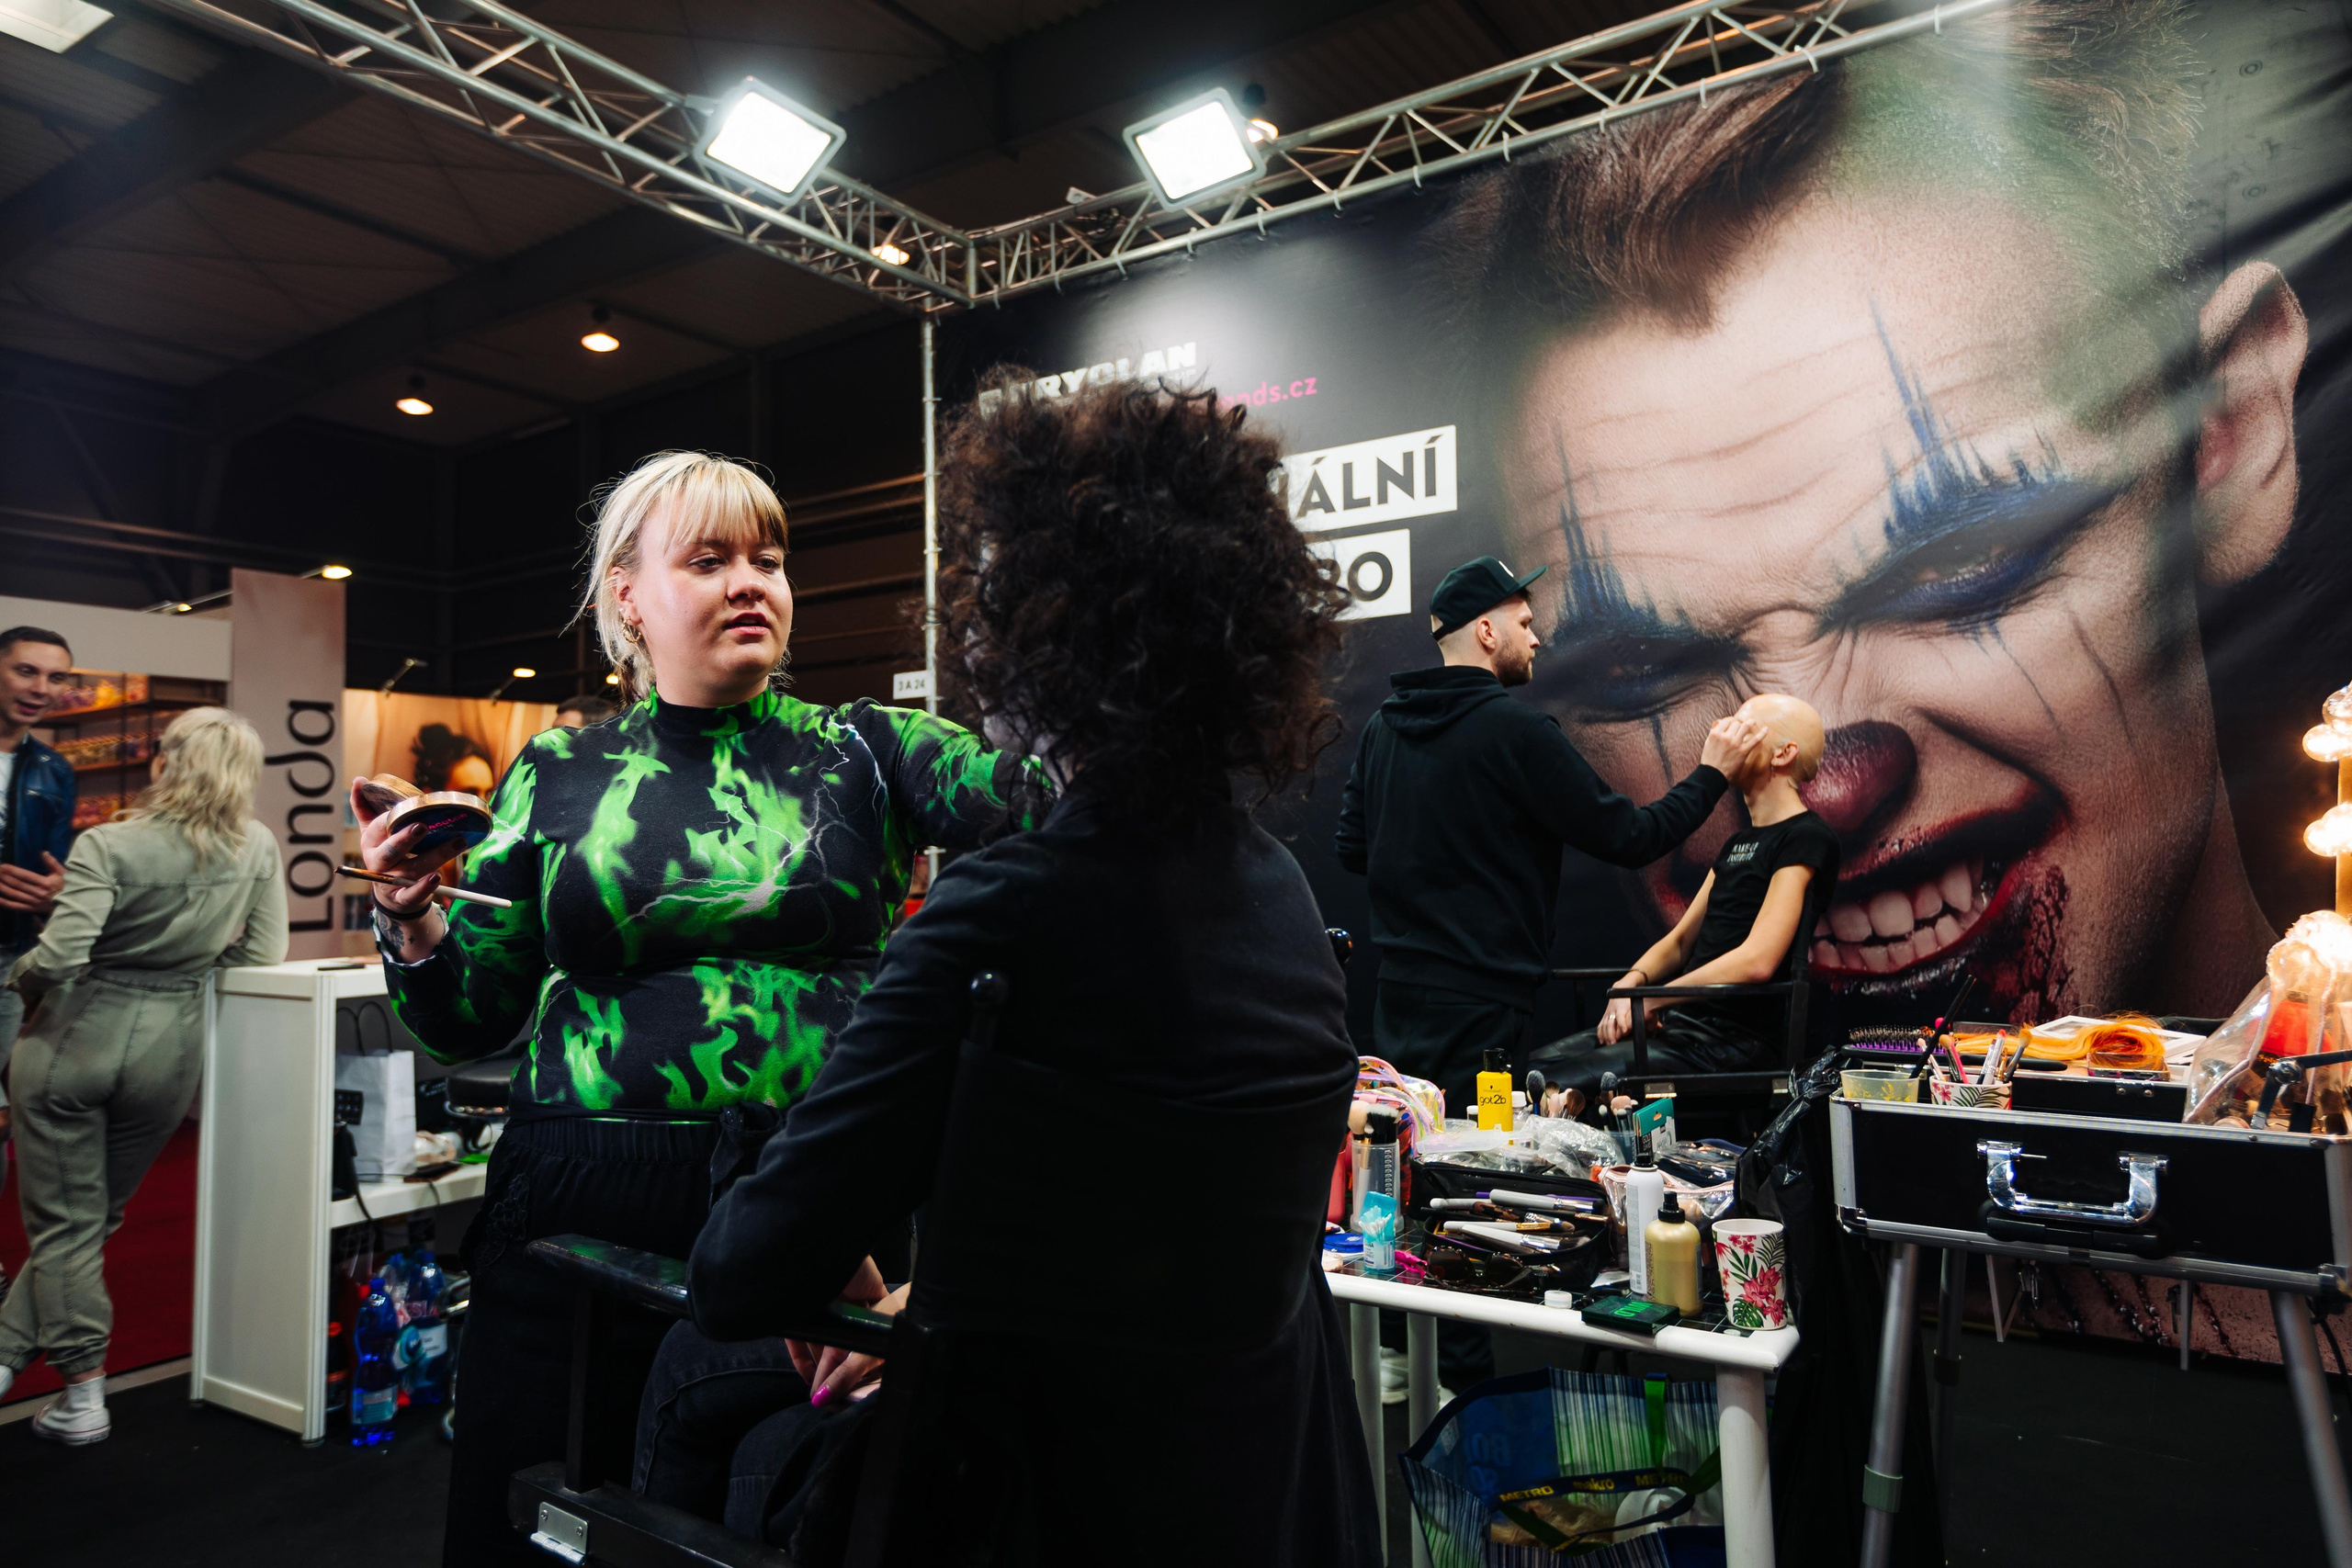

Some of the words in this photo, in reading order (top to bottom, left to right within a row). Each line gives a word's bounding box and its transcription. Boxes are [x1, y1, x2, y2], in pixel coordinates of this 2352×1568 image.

[264, 700, 336, 933] Londa
[1479, 1094, 1507, 1106] got2b
[1499, 1485, 1555, 1502] METRO
